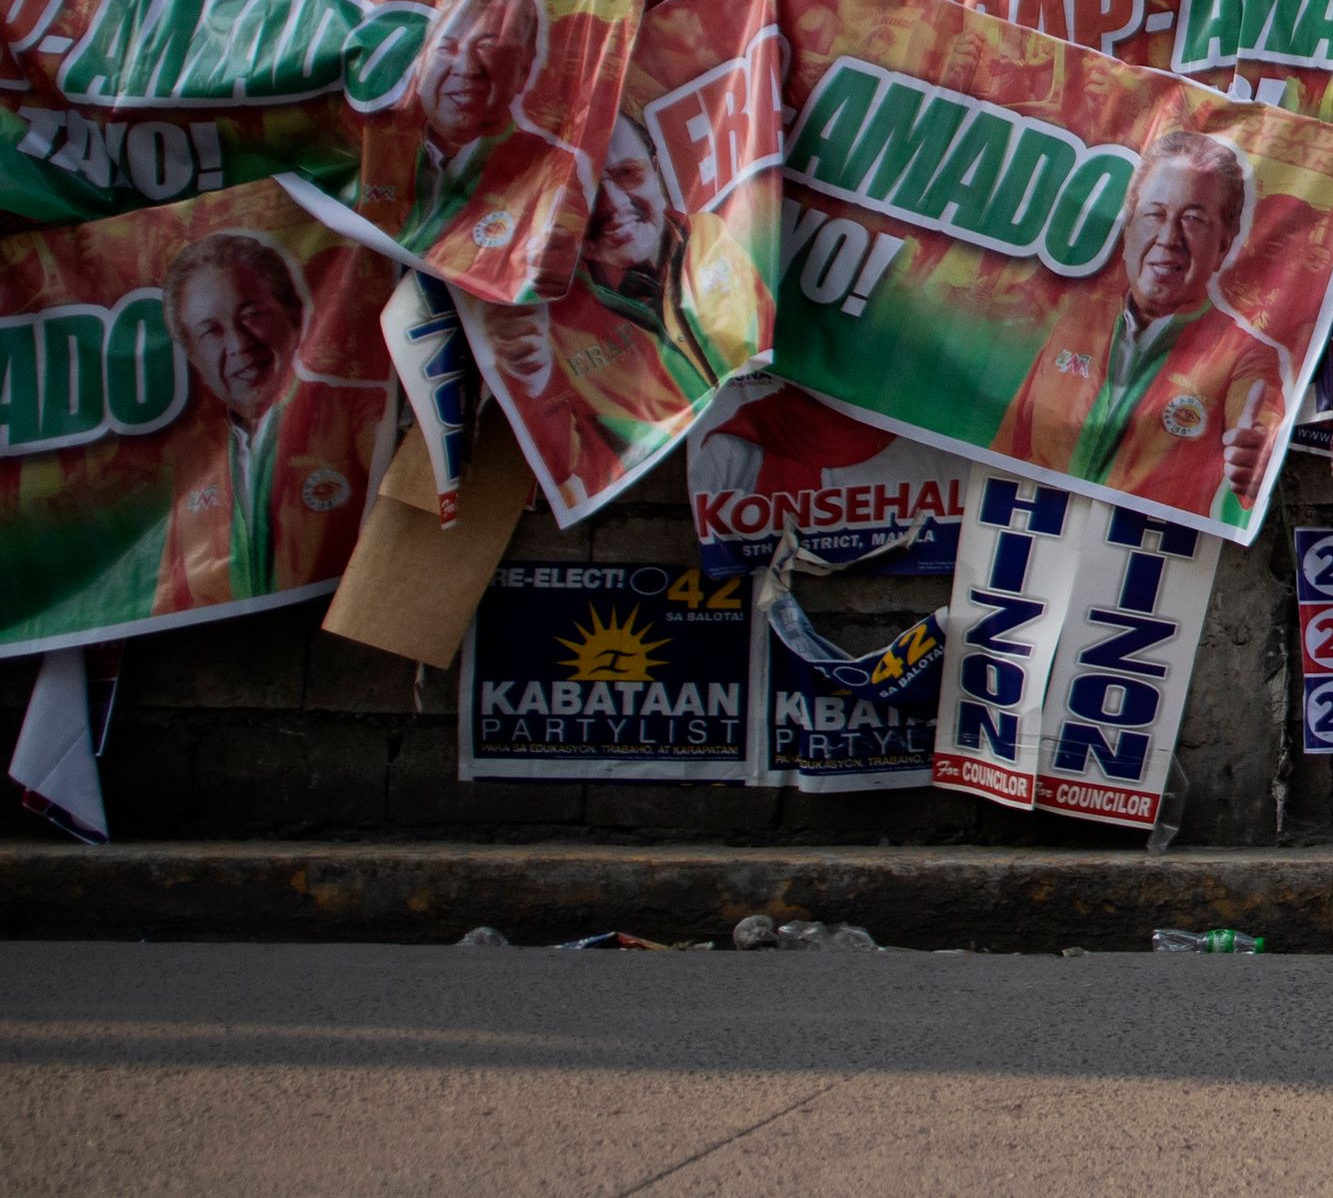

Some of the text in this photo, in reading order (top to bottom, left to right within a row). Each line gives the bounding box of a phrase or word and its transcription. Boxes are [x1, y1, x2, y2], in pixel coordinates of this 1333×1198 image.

[17, 106, 225, 201] TAYO!
[695, 477, 966, 539] KONSEHAL
[742, 540, 773, 557] 5TH
[687, 611, 744, 622] BALOTA!
[956, 477, 1071, 764] HIZON
[869, 624, 936, 686] 42
[1053, 504, 1199, 783] HIZON
[481, 680, 740, 717] KABATAAN
[481, 719, 741, 745] PARTYLIST
[962, 762, 1028, 799] COUNCILOR
[1055, 781, 1150, 818] COUNCILOR
